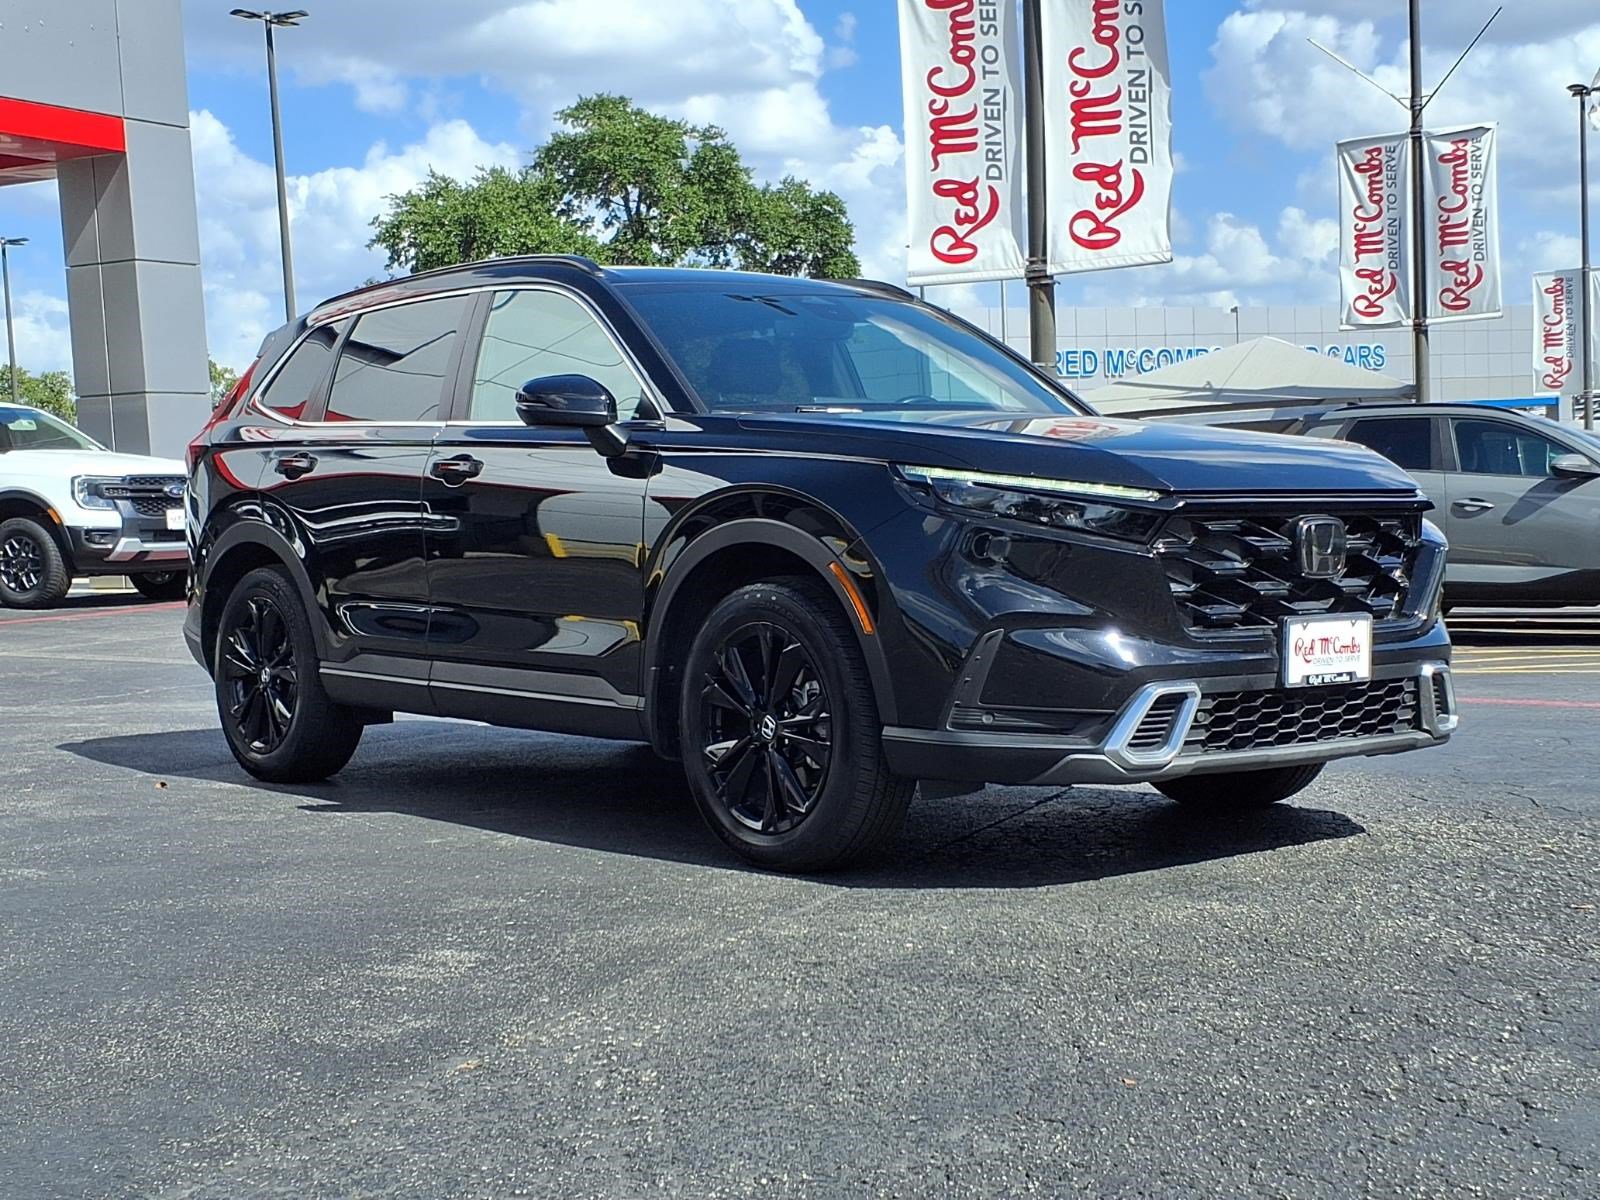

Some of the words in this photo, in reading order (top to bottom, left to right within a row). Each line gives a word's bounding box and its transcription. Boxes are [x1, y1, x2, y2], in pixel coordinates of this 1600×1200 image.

[981, 45, 1000, 80] TO
[1125, 24, 1144, 61] TO
[925, 0, 979, 172] McCom
[983, 88, 1003, 181] DRIVEN
[1128, 69, 1148, 164] DRIVEN
[1385, 145, 1397, 189] SERVE
[1471, 137, 1482, 180] SERVE
[1068, 158, 1144, 250] Red
[1353, 146, 1384, 264] McCombs
[1386, 193, 1397, 213] TO
[1438, 138, 1469, 256] McCombs
[1472, 183, 1483, 206] TO
[930, 176, 999, 264] Red
[1473, 208, 1485, 262] DRIVEN
[1388, 218, 1399, 270] DRIVEN
[1352, 267, 1397, 317] Red
[1439, 258, 1483, 311] Red
[1543, 277, 1564, 353] McCombs
[1566, 308, 1574, 322] TO
[1056, 349, 1098, 375] RED
[1566, 324, 1574, 358] DRIVEN
[1542, 355, 1572, 389] Red
[1295, 637, 1316, 663] Red
[1317, 636, 1360, 655] McCombs
[1312, 656, 1334, 664] DRIVEN
